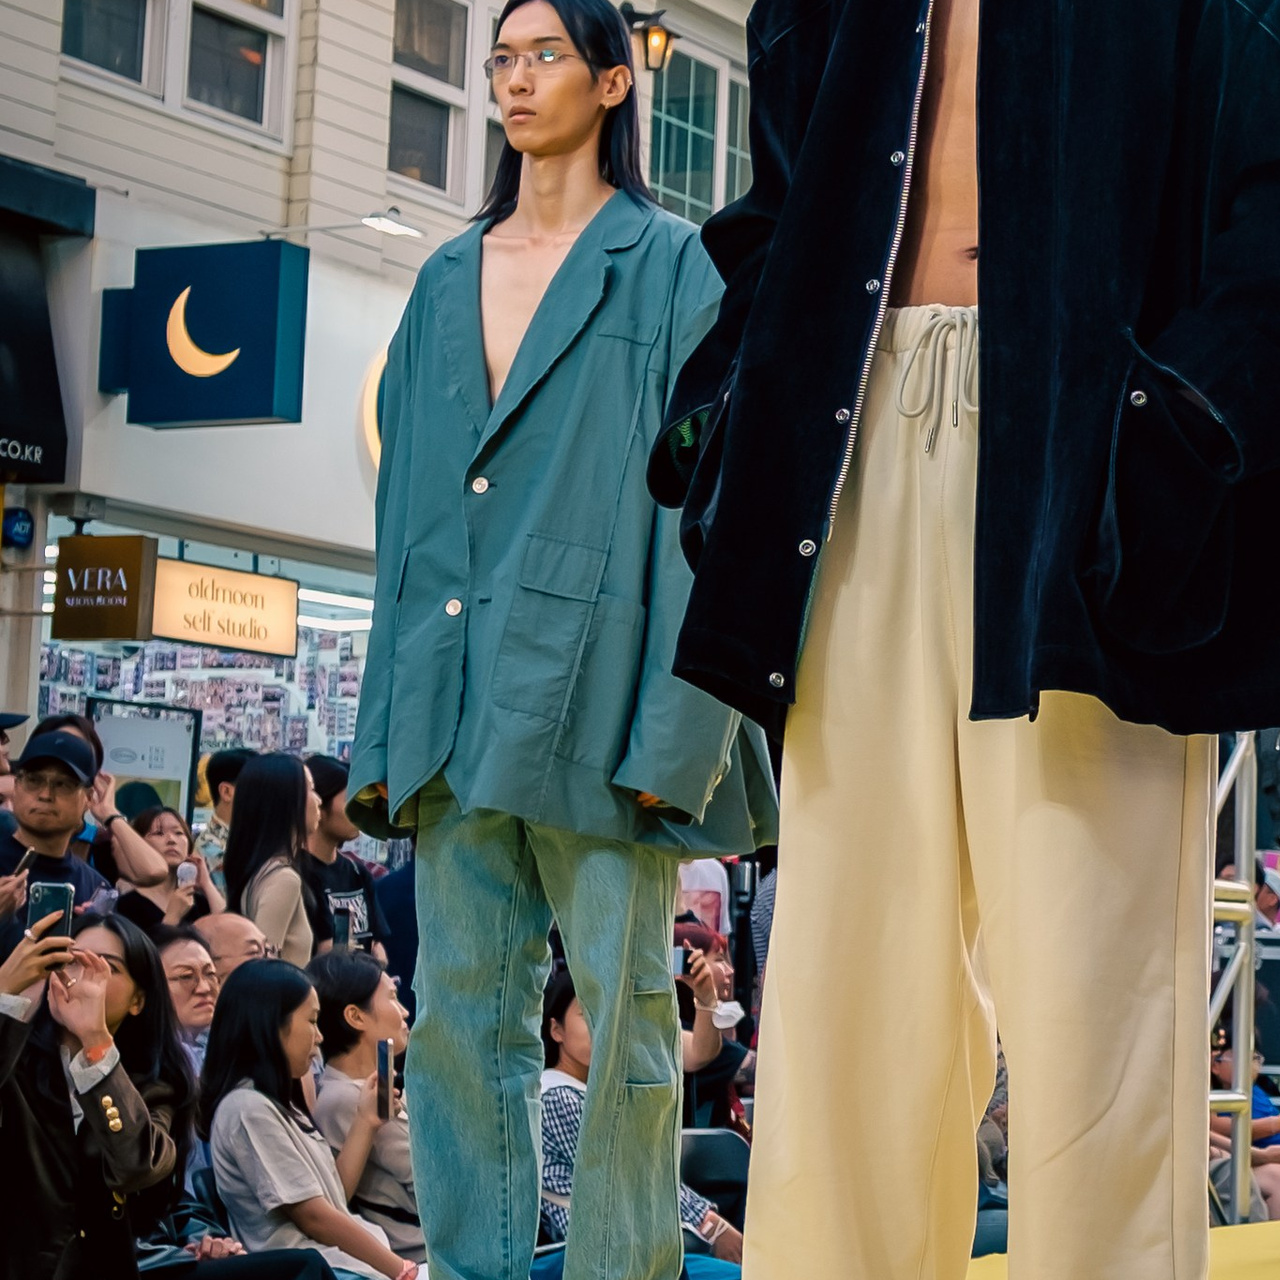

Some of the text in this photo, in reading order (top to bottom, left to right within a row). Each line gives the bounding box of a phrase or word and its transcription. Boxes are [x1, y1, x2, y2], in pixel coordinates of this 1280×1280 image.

[67, 567, 128, 591] VERA
[188, 578, 266, 611] oldmoon
[183, 609, 268, 641] self studio
